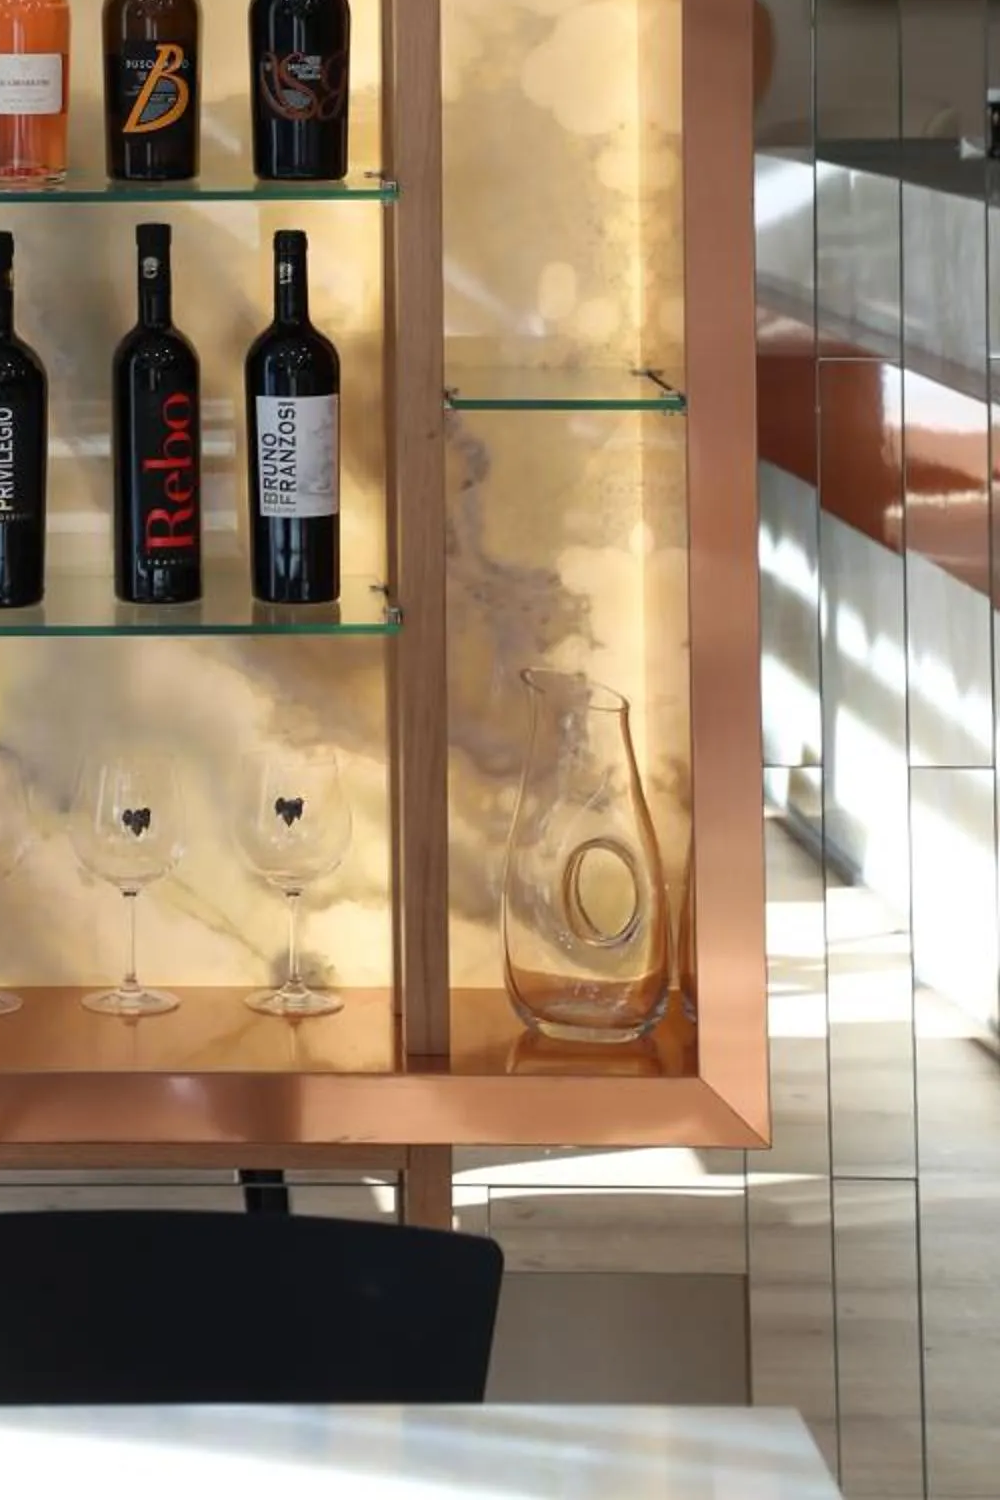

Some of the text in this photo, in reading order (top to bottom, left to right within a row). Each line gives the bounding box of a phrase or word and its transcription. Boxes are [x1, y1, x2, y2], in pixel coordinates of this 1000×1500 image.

[142, 391, 194, 551] Rebo
[262, 432, 278, 505] BRUNO
[278, 401, 297, 505] FRANZOSI
